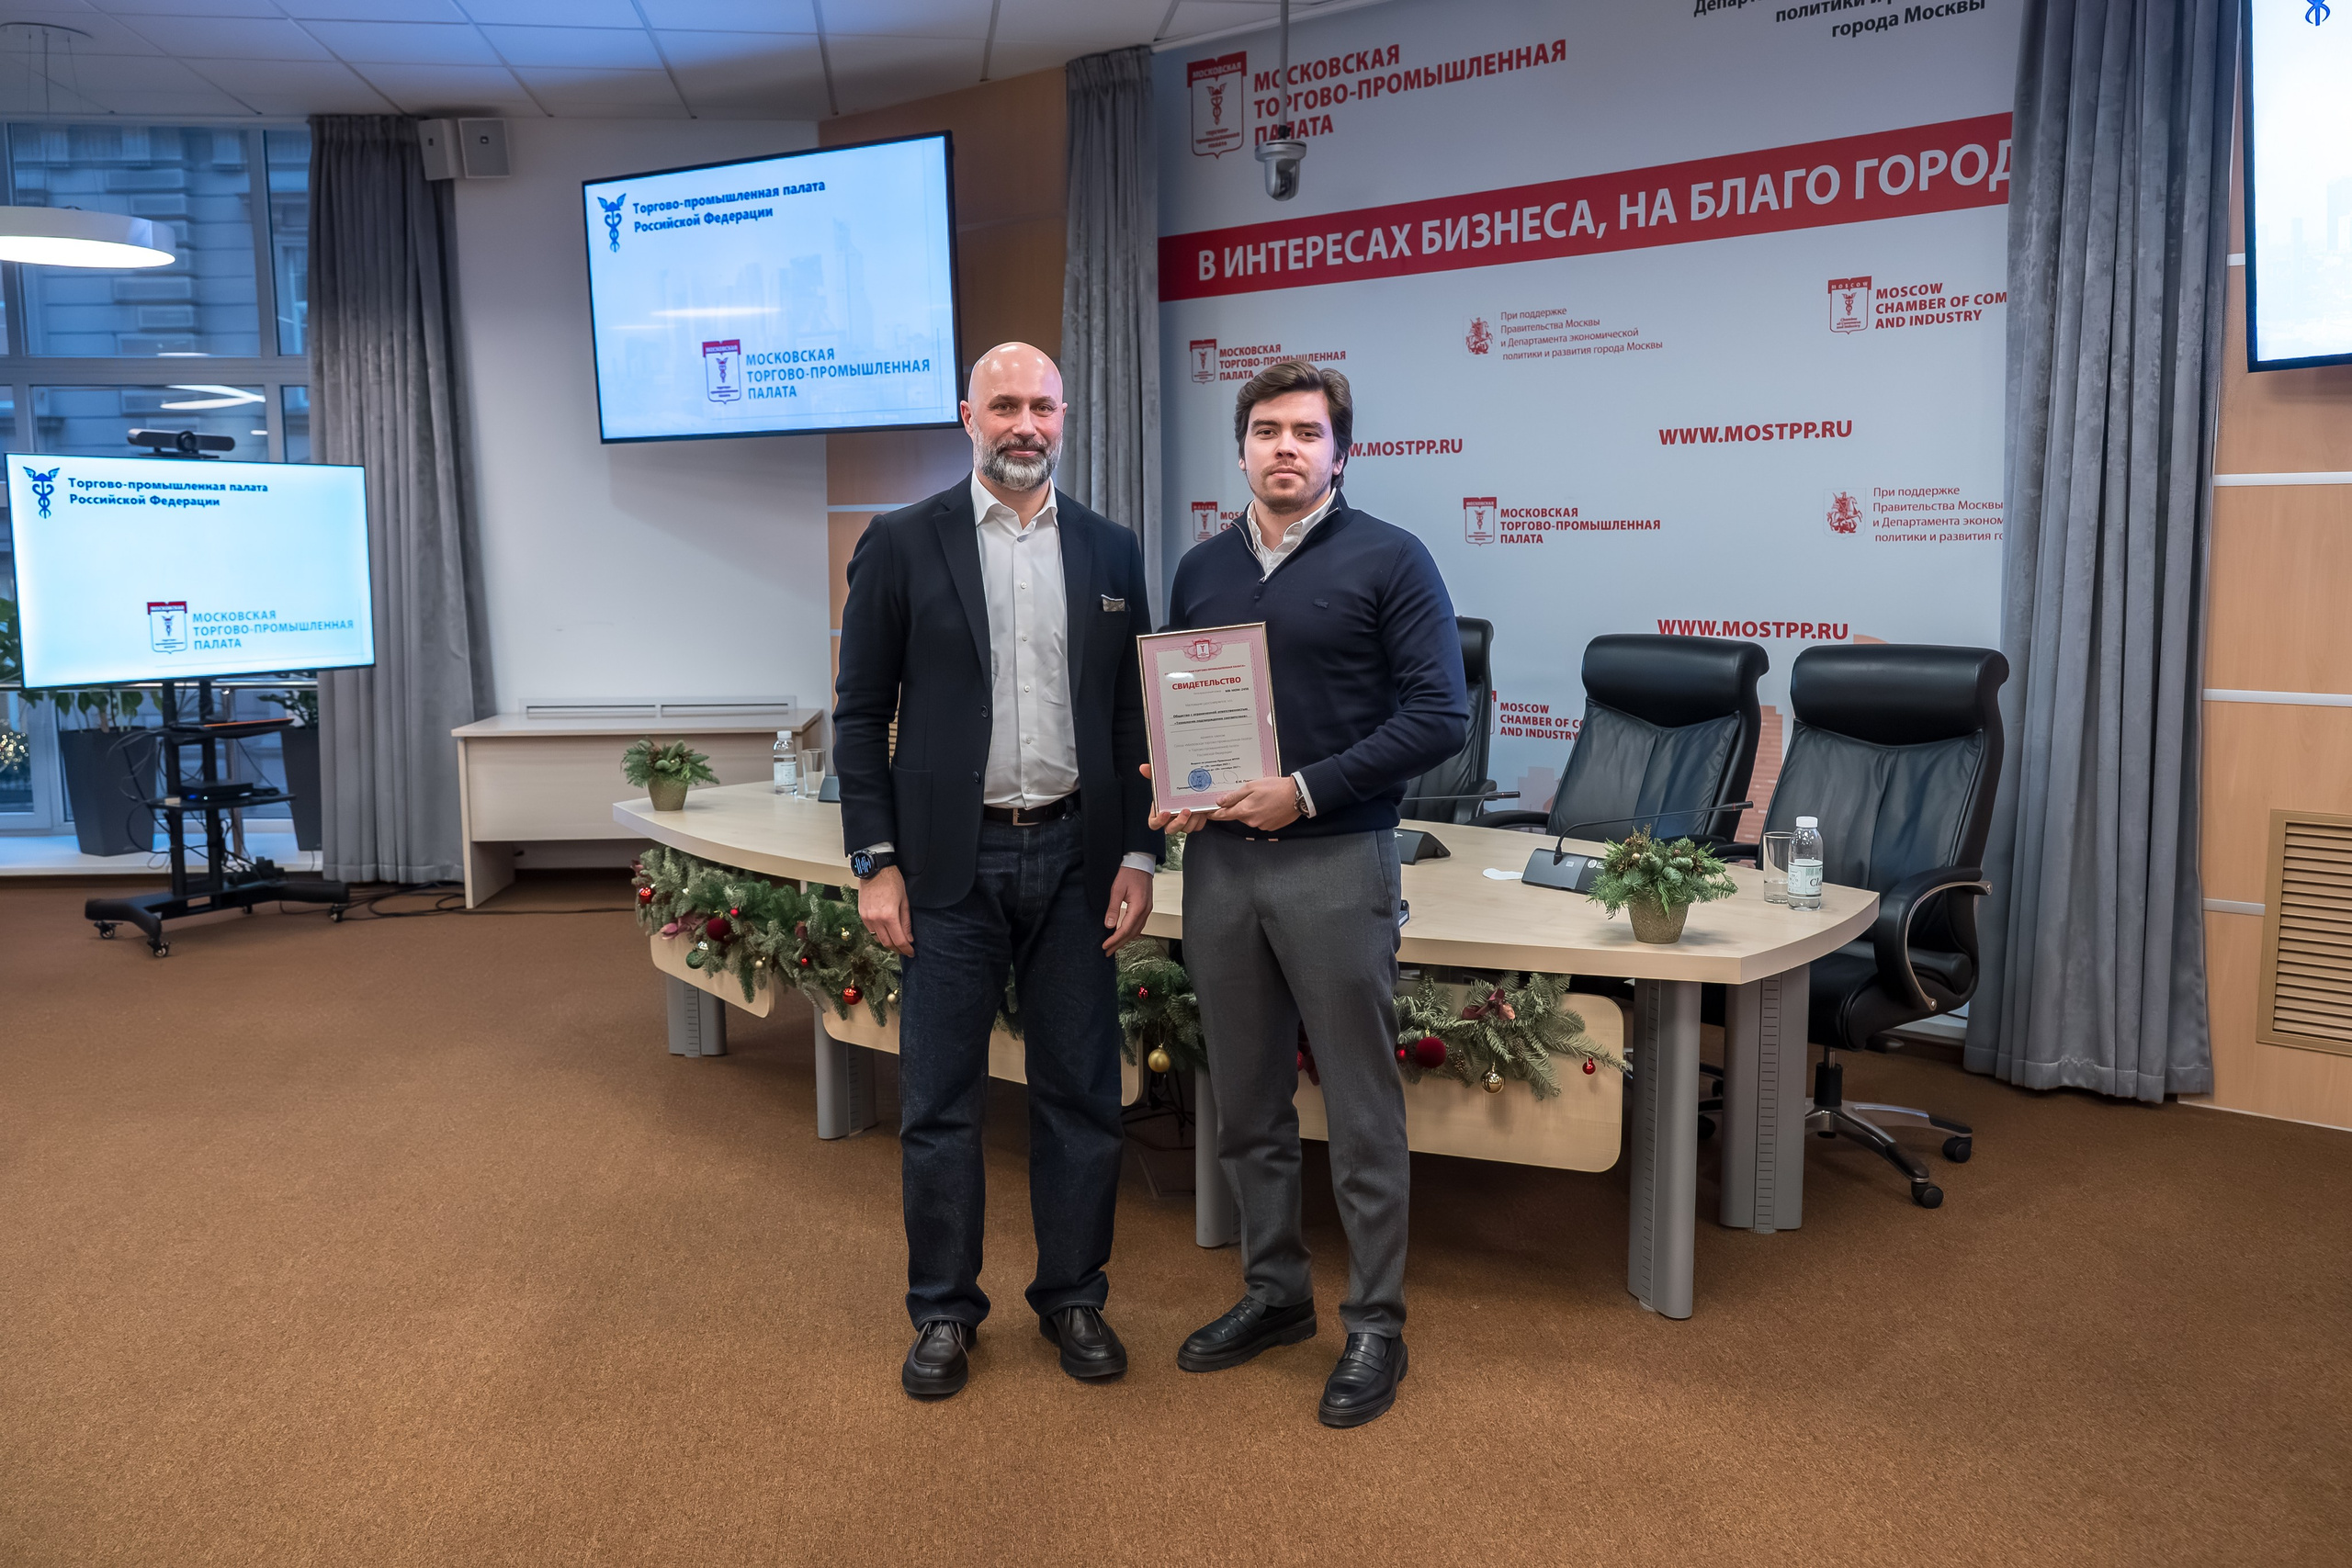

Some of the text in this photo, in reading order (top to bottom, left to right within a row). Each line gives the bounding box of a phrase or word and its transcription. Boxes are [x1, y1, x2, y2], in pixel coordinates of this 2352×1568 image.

[1832, 0, 1985, 38] города Москвы
[1254, 44, 1400, 93] МОСКОВСКАЯ
[633, 181, 826, 216] Торгово-промышленная палата
[634, 208, 774, 232] Российской Федерации
[1198, 250, 1216, 281] В
[1225, 224, 1412, 278] ИНТЕРЕСАХ
[1421, 199, 1608, 255] БИЗНЕСА,
[1619, 187, 1678, 231] НА
[1690, 164, 1841, 221] БЛАГО
[1876, 283, 1943, 299] MOSCOW
[1875, 291, 2007, 314] CHAMBER OF COM
[1500, 308, 1567, 321] При поддержке
[1875, 309, 1983, 330] AND INDUSTRY
[1500, 319, 1600, 335] Правительства Москвы
[1508, 334, 1567, 349] Департамента
[1569, 327, 1639, 341] экономической
[746, 348, 835, 366] МОСКОВСКАЯ
[1219, 344, 1281, 357] МОСКОВСКАЯ
[1502, 351, 1542, 361] политики
[1552, 346, 1591, 358] развития
[1594, 344, 1624, 355] города
[1626, 341, 1663, 351] Москвы
[747, 359, 930, 383] ТОРГОВО-ПРОМЫШЛЕННАЯ
[1219, 370, 1254, 381] ПАЛАТА
[748, 386, 797, 400] ПАЛАТА
[1658, 420, 1852, 445] WWW.MOSTPP.RU
[68, 478, 268, 492] Торгово-промышленная палата
[1873, 487, 1960, 499] При поддержке
[70, 494, 220, 508] Российской Федерации
[1873, 501, 2003, 513] Правительства Москвы
[1500, 508, 1578, 518] МОСКОВСКАЯ
[1500, 520, 1661, 531] ТОРГОВО-ПРОМЫШЛЕННАЯ
[1882, 517, 1960, 529] Департамента
[1500, 534, 1544, 544] ПАЛАТА
[1875, 533, 1927, 542] политики
[1939, 532, 1991, 543] развития
[192, 610, 277, 623] МОСКОВСКАЯ
[194, 620, 354, 636] ТОРГОВО-ПРОМЫШЛЕННАЯ
[1657, 619, 1849, 640] WWW.MOSTPP.RU
[194, 638, 242, 650] ПАЛАТА
[1172, 677, 1241, 690] СВИДЕТЕЛЬСТВО
[1500, 703, 1550, 714] MOSCOW
[1500, 715, 1552, 727] CHAMBER
[1555, 718, 1569, 728] OF
[1500, 727, 1578, 740] AND INDUSTRY
